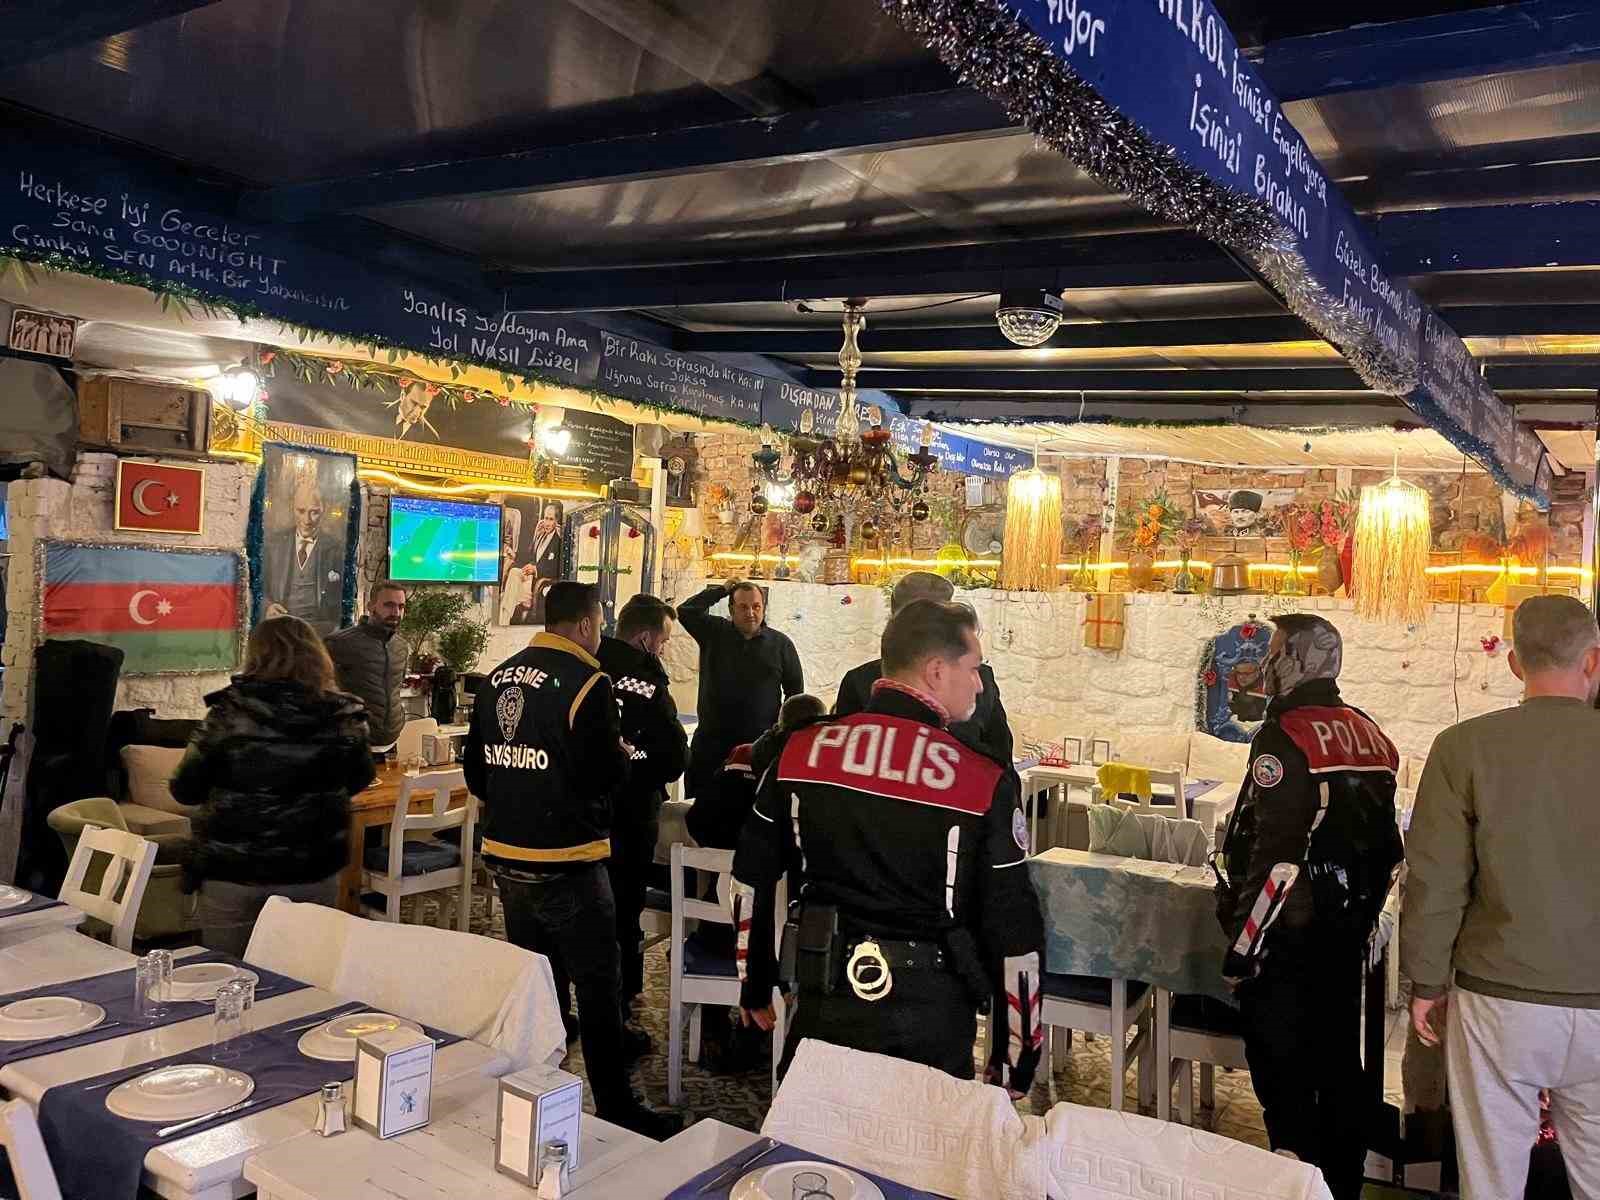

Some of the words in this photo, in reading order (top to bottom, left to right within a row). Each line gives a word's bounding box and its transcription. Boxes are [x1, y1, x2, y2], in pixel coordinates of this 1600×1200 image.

[1190, 73, 1242, 174] İşinizi
[1254, 153, 1309, 239] Bırakın
[20, 170, 107, 215] Herkese
[160, 208, 261, 247] Geceler
[51, 211, 116, 241] Sana
[104, 245, 155, 269] SEN
[223, 270, 251, 289] Bir
[403, 289, 467, 327] Yanlış
[555, 328, 588, 352] Ama
[430, 325, 458, 351] Yol
[471, 338, 519, 365] Nasıl
[528, 348, 578, 374] Güzel
[604, 336, 624, 357] Bir
[629, 342, 657, 365] Rakı
[660, 353, 719, 378] Sofrasında
[646, 376, 676, 393] Sofra
[491, 666, 548, 688] ÇEŞME
[512, 743, 549, 770] BÜRO
[807, 724, 961, 790] POLİS
